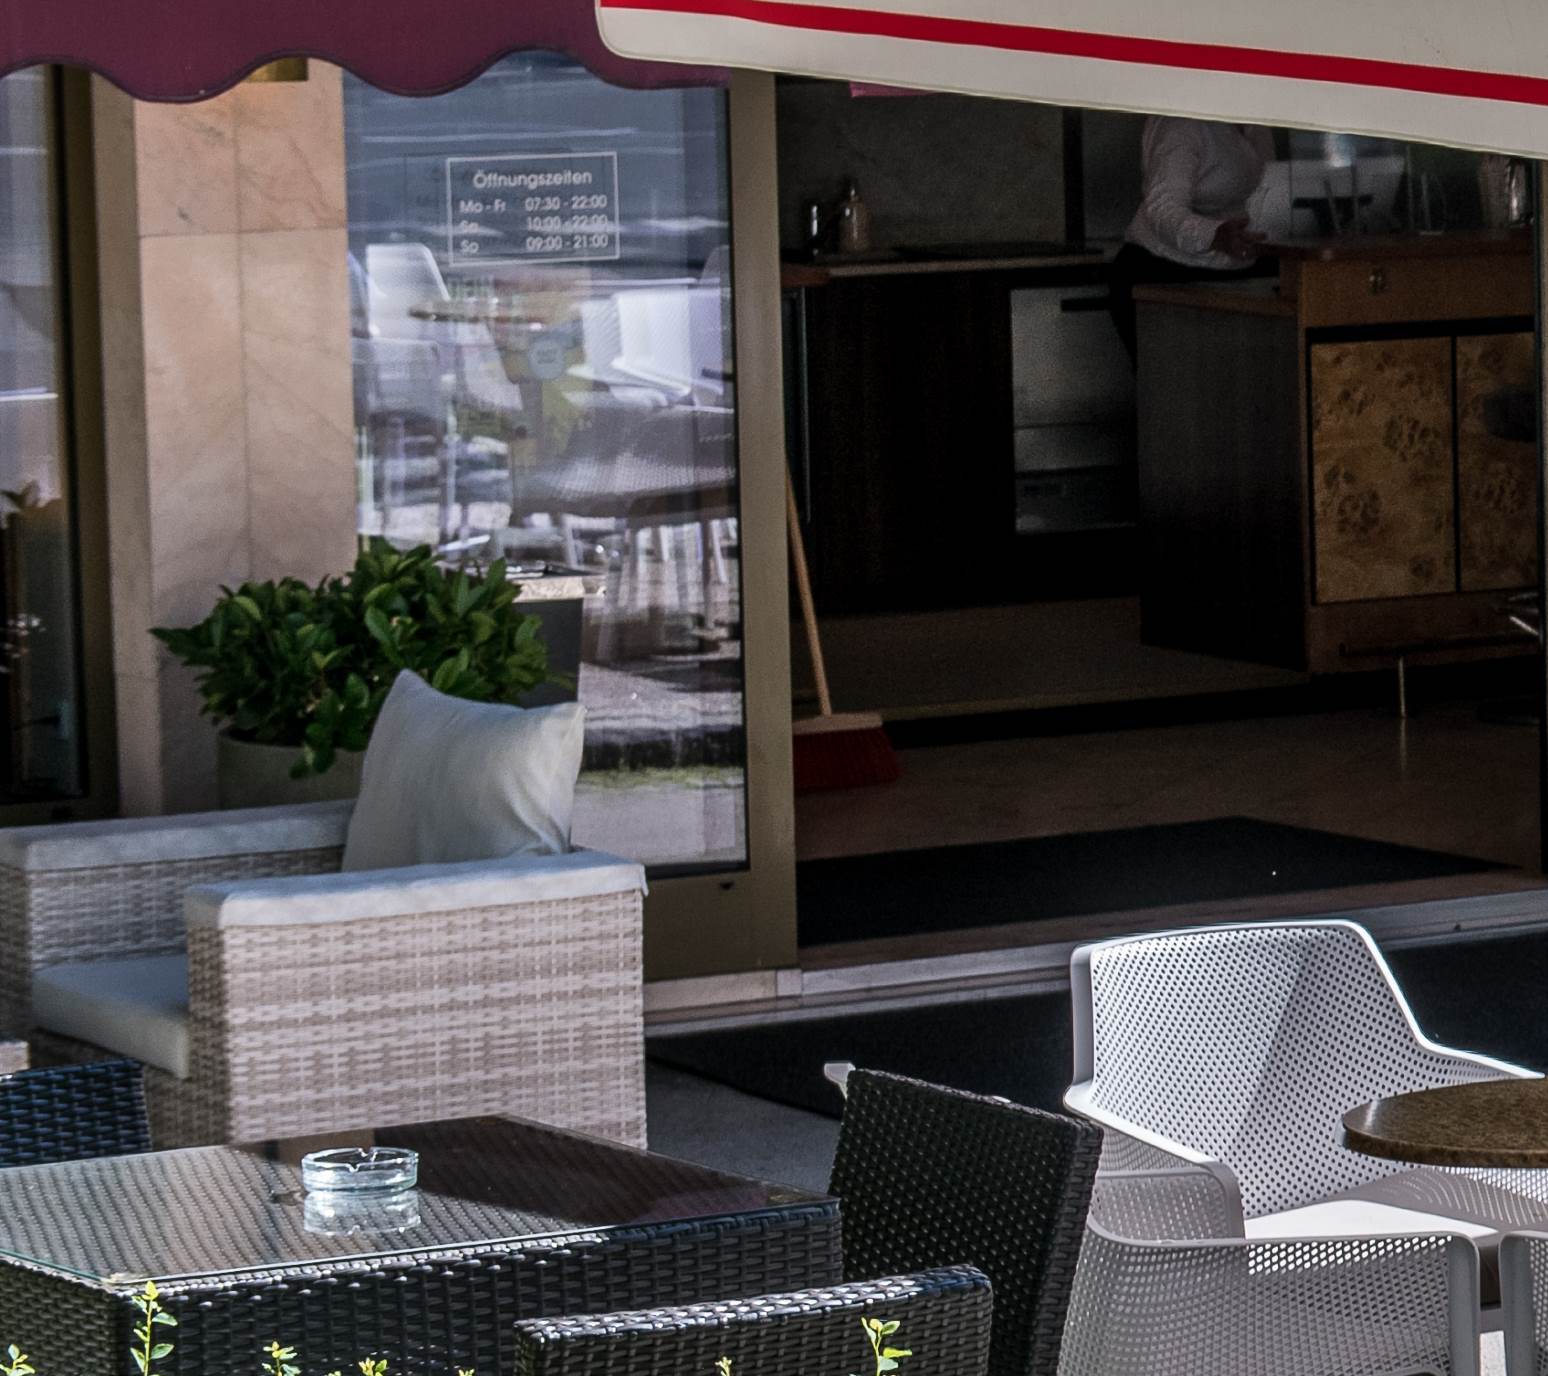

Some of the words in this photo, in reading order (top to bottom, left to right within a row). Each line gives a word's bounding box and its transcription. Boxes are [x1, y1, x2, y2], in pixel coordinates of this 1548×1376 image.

[472, 169, 593, 190] Öffnungszeiten
[459, 200, 483, 214] Mo
[493, 199, 507, 213] Fr
[525, 196, 561, 211] 07:30
[571, 194, 608, 210] 22:00
[460, 239, 480, 254] So
[573, 234, 609, 249] 21:00
